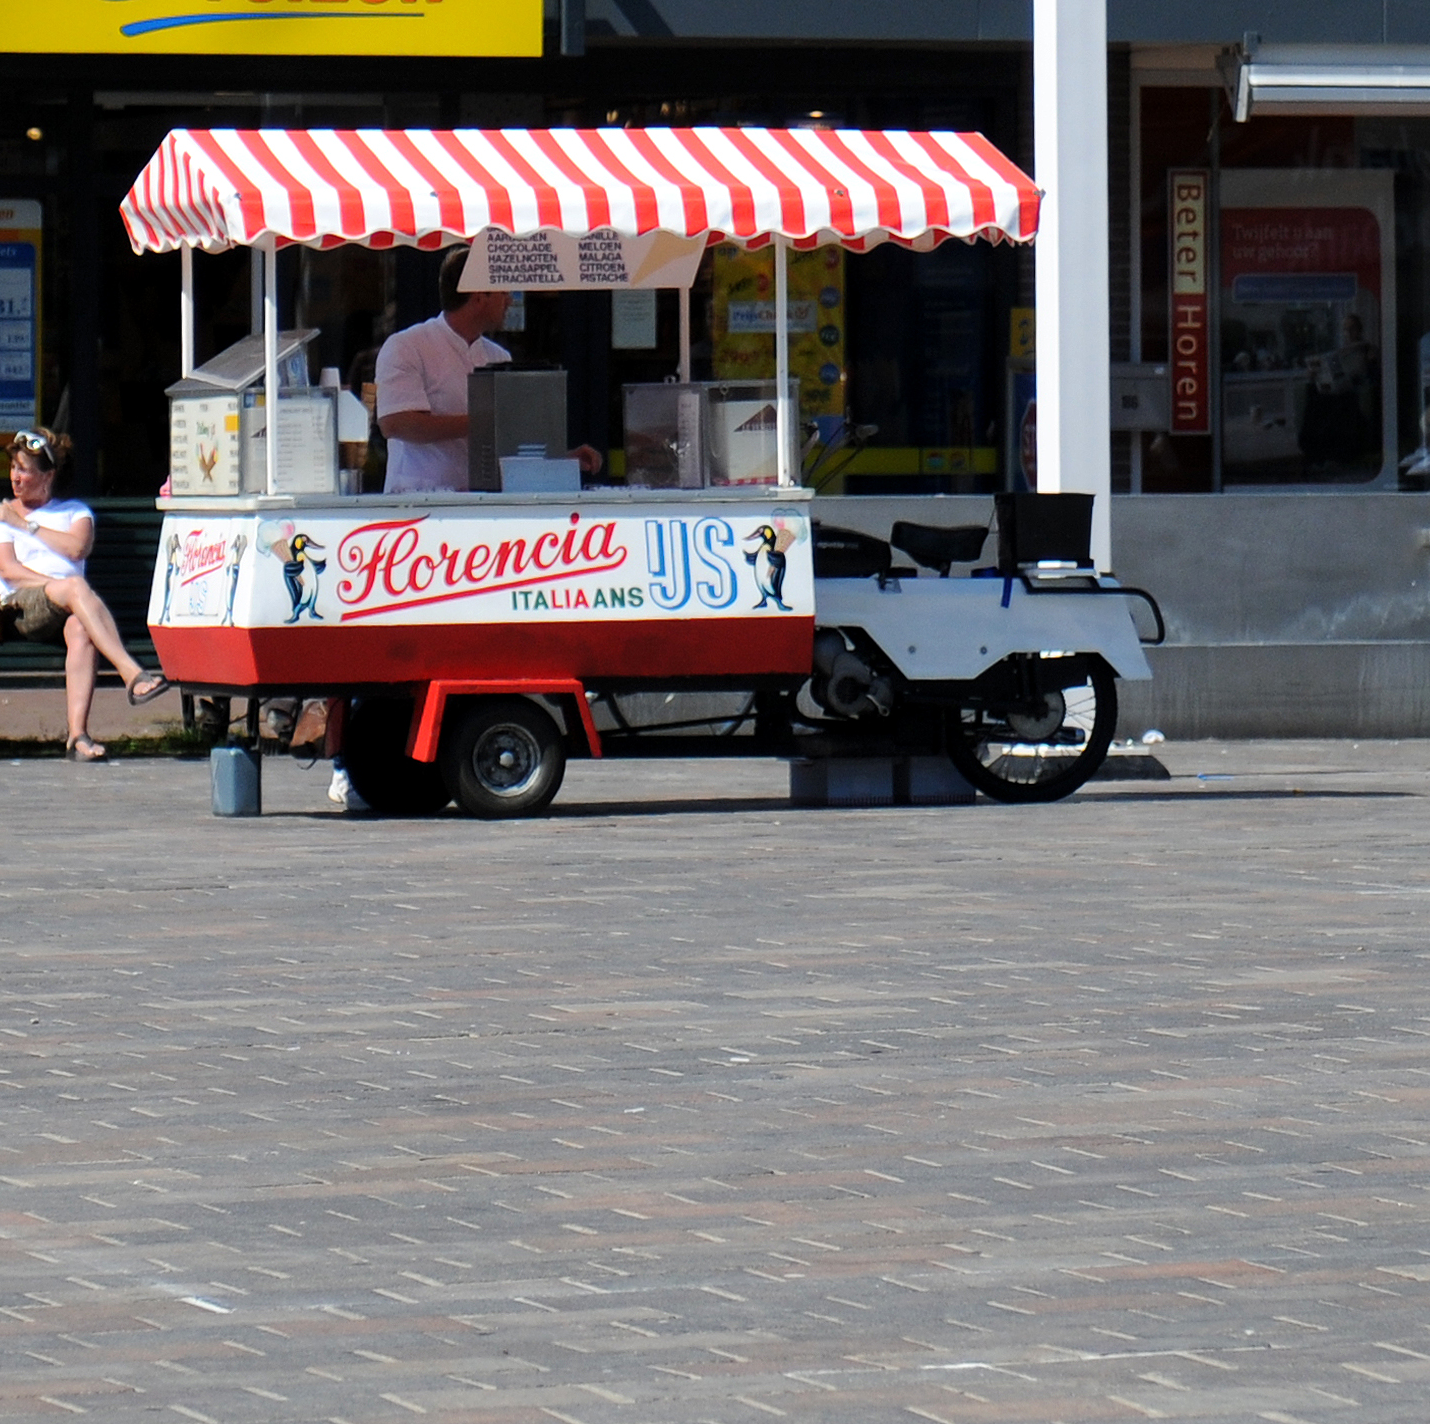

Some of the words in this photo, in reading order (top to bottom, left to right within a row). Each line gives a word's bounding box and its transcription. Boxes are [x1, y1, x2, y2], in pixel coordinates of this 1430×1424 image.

[1176, 182, 1201, 283] Beter
[487, 243, 552, 253] CHOCOLADE
[579, 242, 622, 251] MELOEN
[488, 254, 558, 264] HAZELNOTEN
[579, 252, 622, 262] MALAGA
[489, 264, 560, 274] SINAASAPPEL
[580, 263, 626, 272] CITROEN
[580, 273, 629, 283] PISTACHE
[1176, 305, 1201, 421] Horen
[336, 512, 628, 604] Florencia
[512, 586, 645, 611] ITALIAANS
[645, 517, 737, 610] IJS
